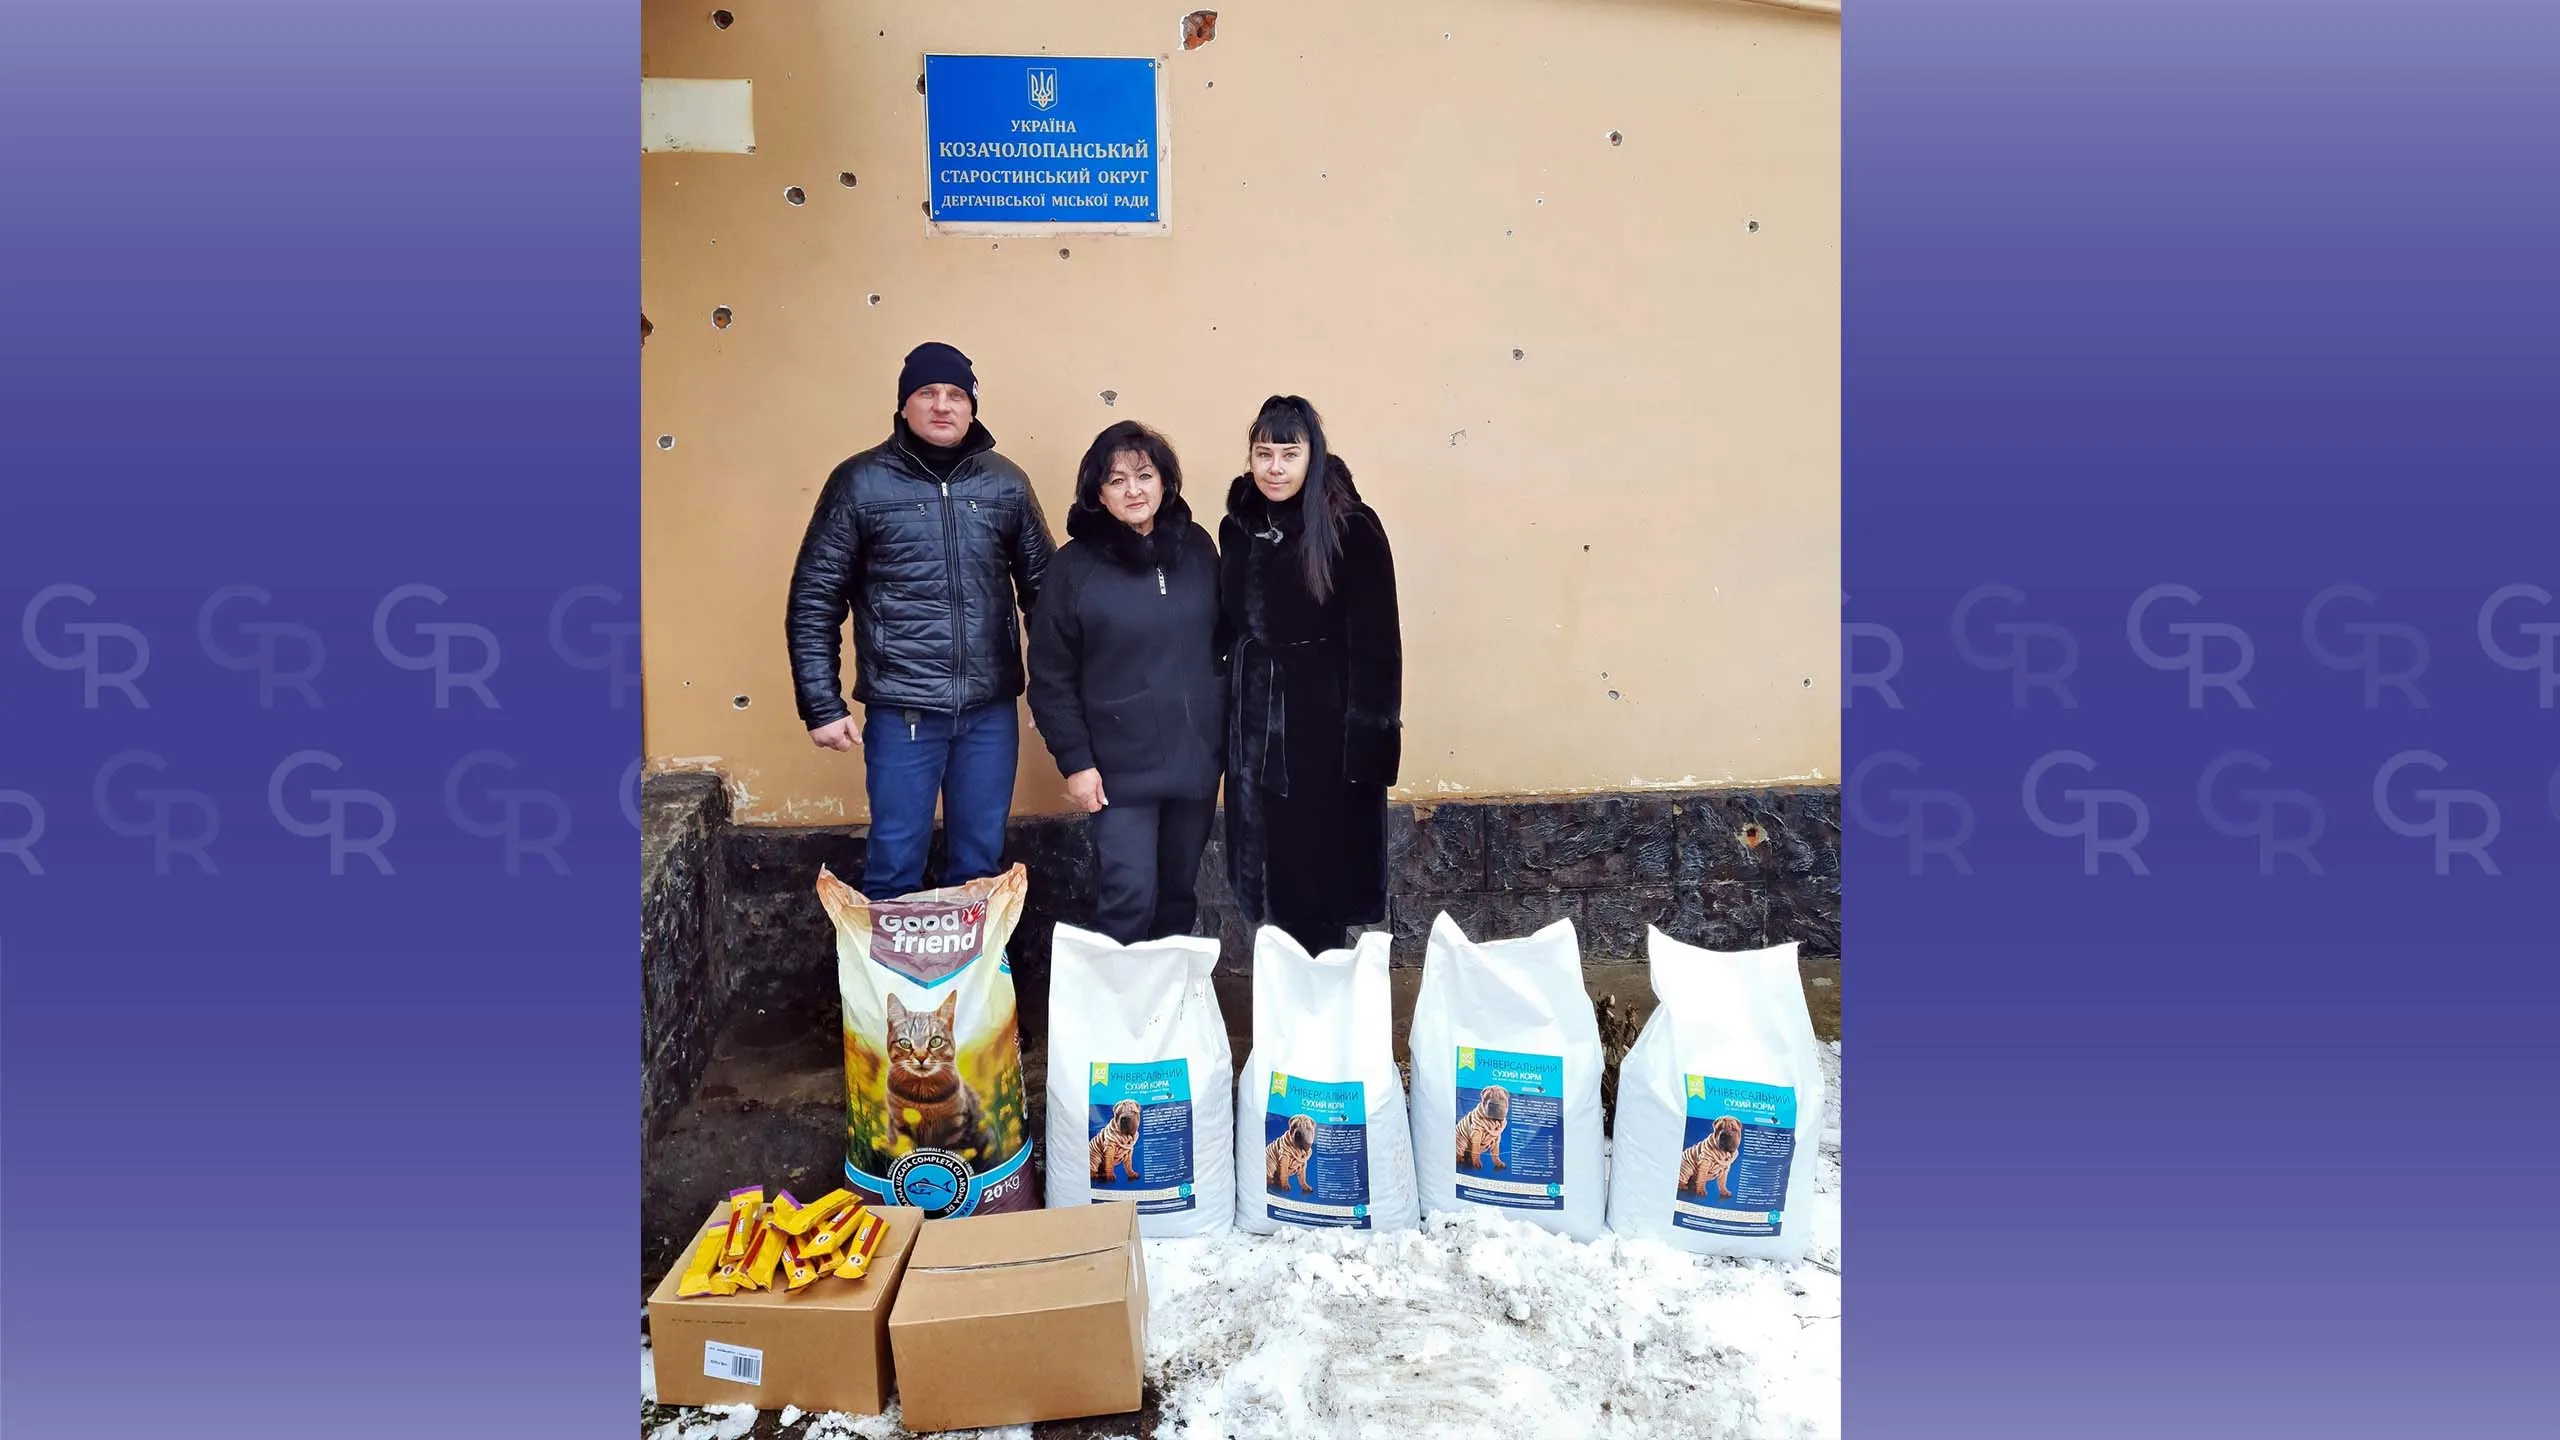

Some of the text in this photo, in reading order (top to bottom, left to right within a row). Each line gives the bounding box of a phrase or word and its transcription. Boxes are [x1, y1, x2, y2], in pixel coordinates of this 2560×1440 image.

[1011, 118, 1076, 133] УКРАЇНА
[939, 139, 1149, 158] КОЗАЧОЛОПАНСЬКИЙ
[940, 168, 1149, 184] СТАРОСТИНСЬКИЙ ОКРУГ
[941, 194, 1149, 208] ДЕРГАЧІВСЬКОЇ МІСЬКОЇ РАДИ
[879, 910, 959, 932] Good
[892, 923, 978, 954] friend
[1476, 1058, 1557, 1073] УНІВЕРСАЛЬНИЙ
[1110, 1068, 1184, 1082] УНІВЕРСАЛЬНИЙ
[1492, 1070, 1542, 1080] СУХИЙ КОРМ
[1707, 1086, 1791, 1105] УНІВЕРСАЛЬНИЙ
[1724, 1099, 1751, 1108] СУХИЙ
[1752, 1103, 1776, 1111] КОРМ
[953, 1166, 963, 1177] CU
[984, 1185, 1003, 1203] 20
[944, 1205, 955, 1214] DE
